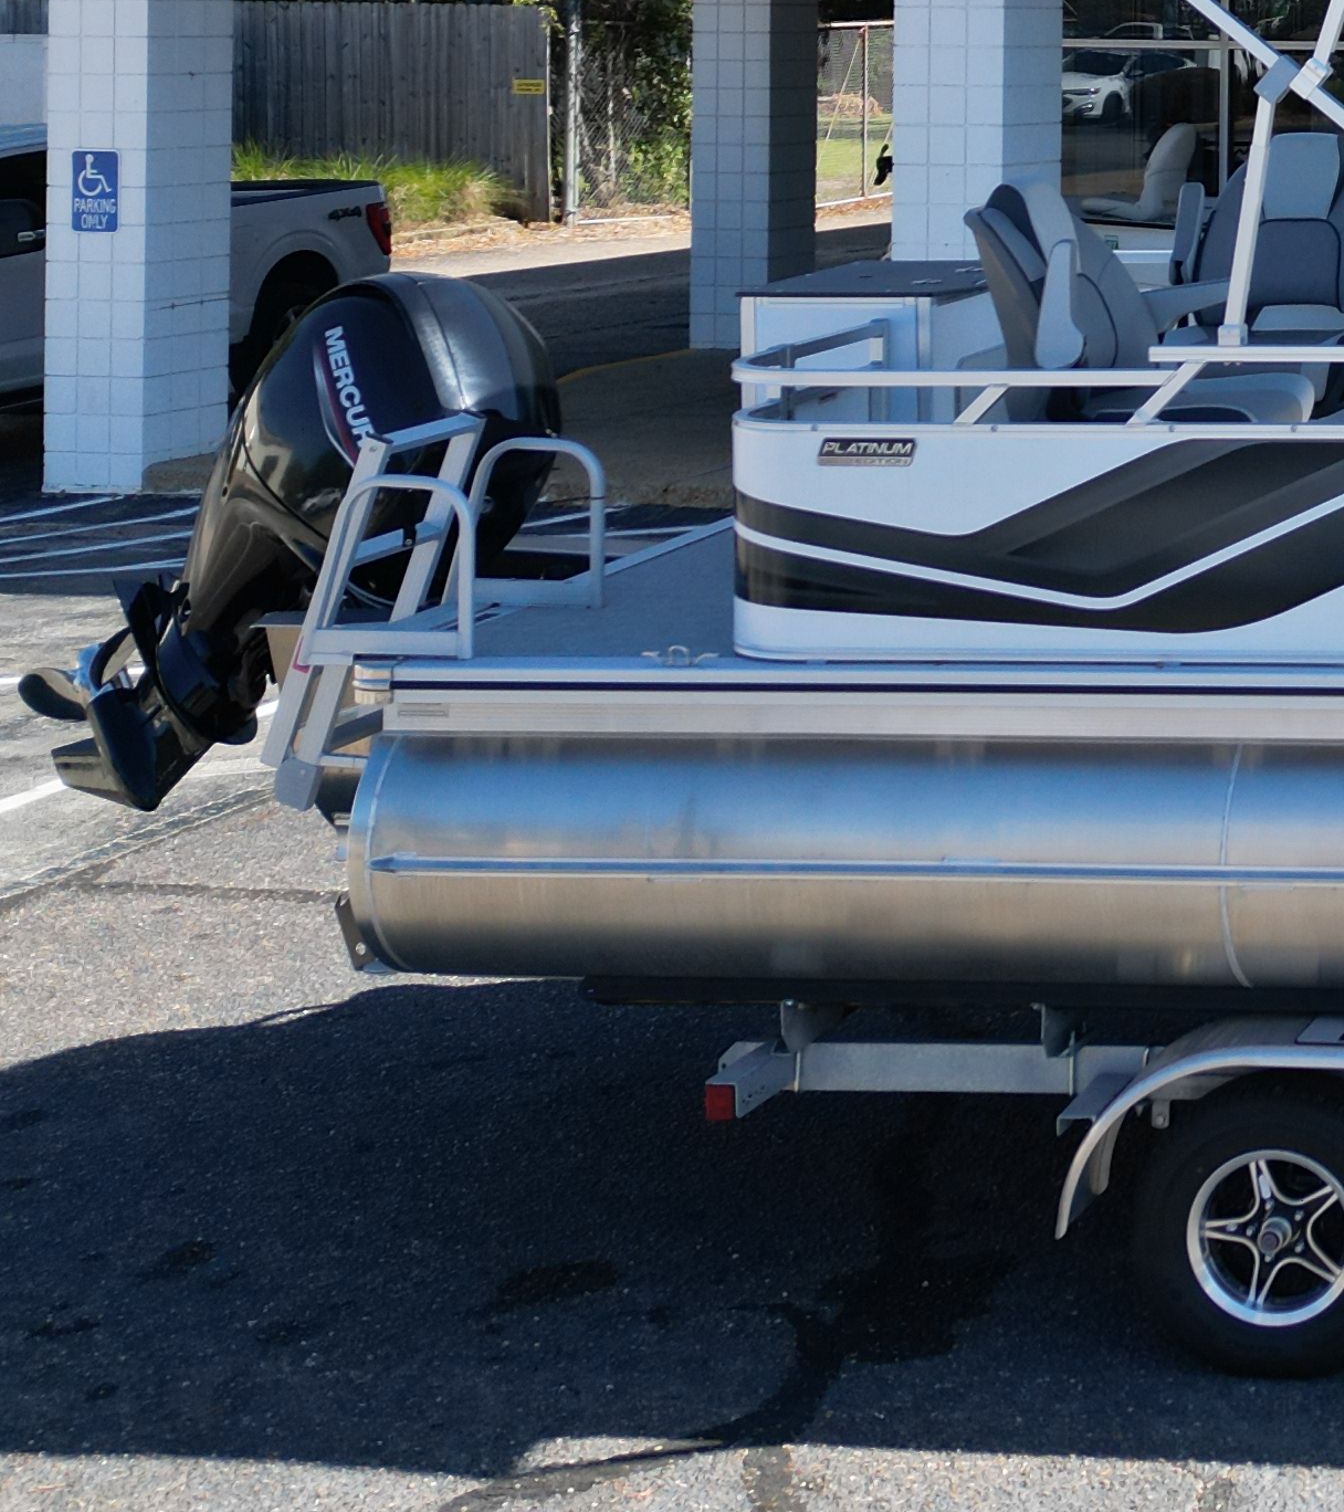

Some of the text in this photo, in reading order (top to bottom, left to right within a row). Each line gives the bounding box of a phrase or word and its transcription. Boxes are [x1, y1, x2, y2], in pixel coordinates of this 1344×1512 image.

[73, 197, 117, 214] PARKING
[80, 214, 109, 230] ONLY
[324, 326, 376, 450] MERCUR
[822, 441, 914, 455] PLATINUM
